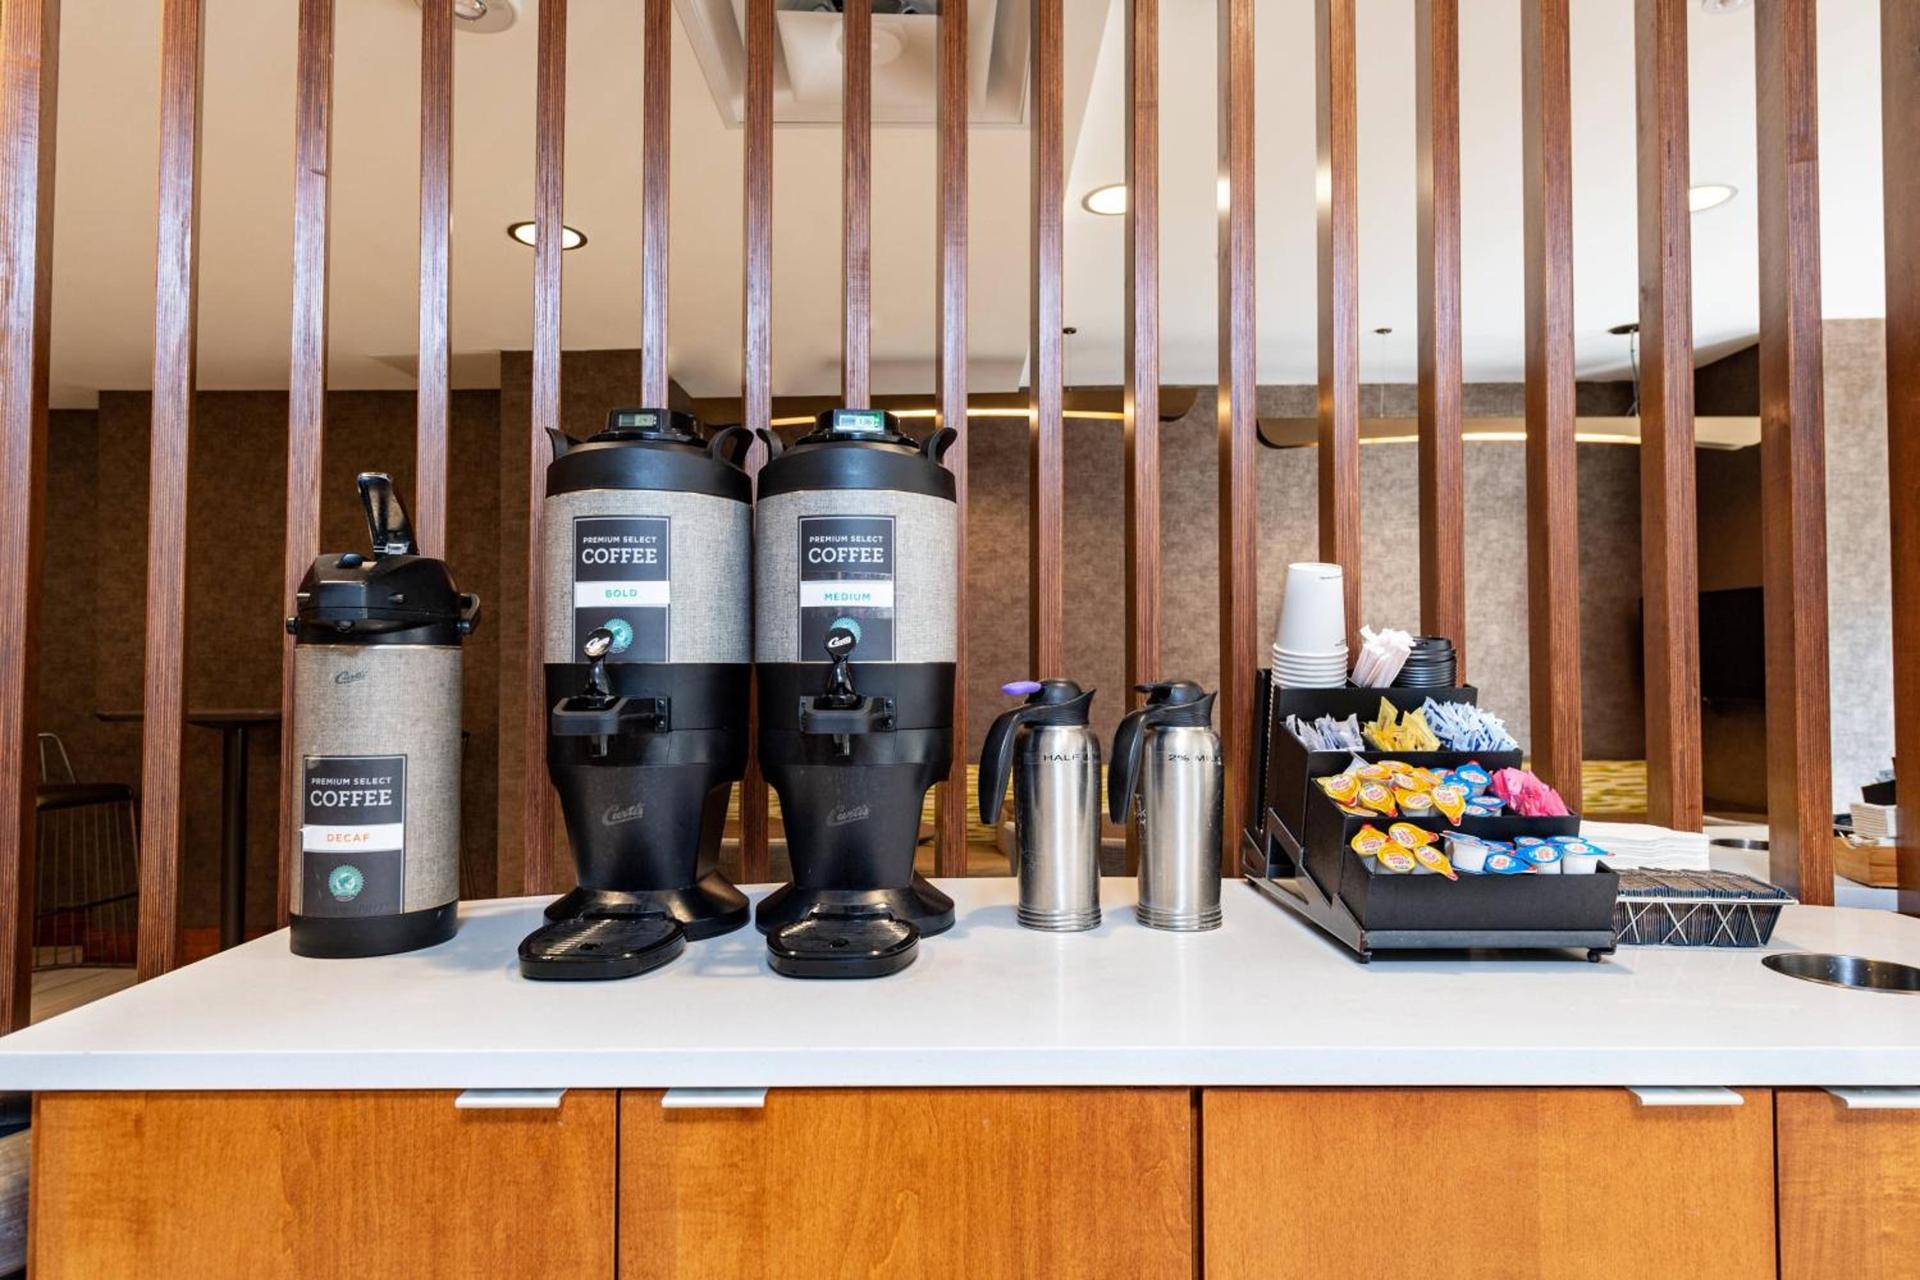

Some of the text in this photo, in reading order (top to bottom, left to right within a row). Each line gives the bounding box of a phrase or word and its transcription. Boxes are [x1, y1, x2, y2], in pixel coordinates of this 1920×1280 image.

[582, 548, 657, 564] COFFEE
[808, 547, 884, 563] COFFEE
[605, 589, 638, 598] BOLD
[824, 592, 871, 601] MEDIUM
[1043, 753, 1080, 761] HALF
[311, 777, 392, 785] PREMIUM SELECT
[310, 790, 392, 807] COFFEE
[327, 833, 370, 843] DECAF
